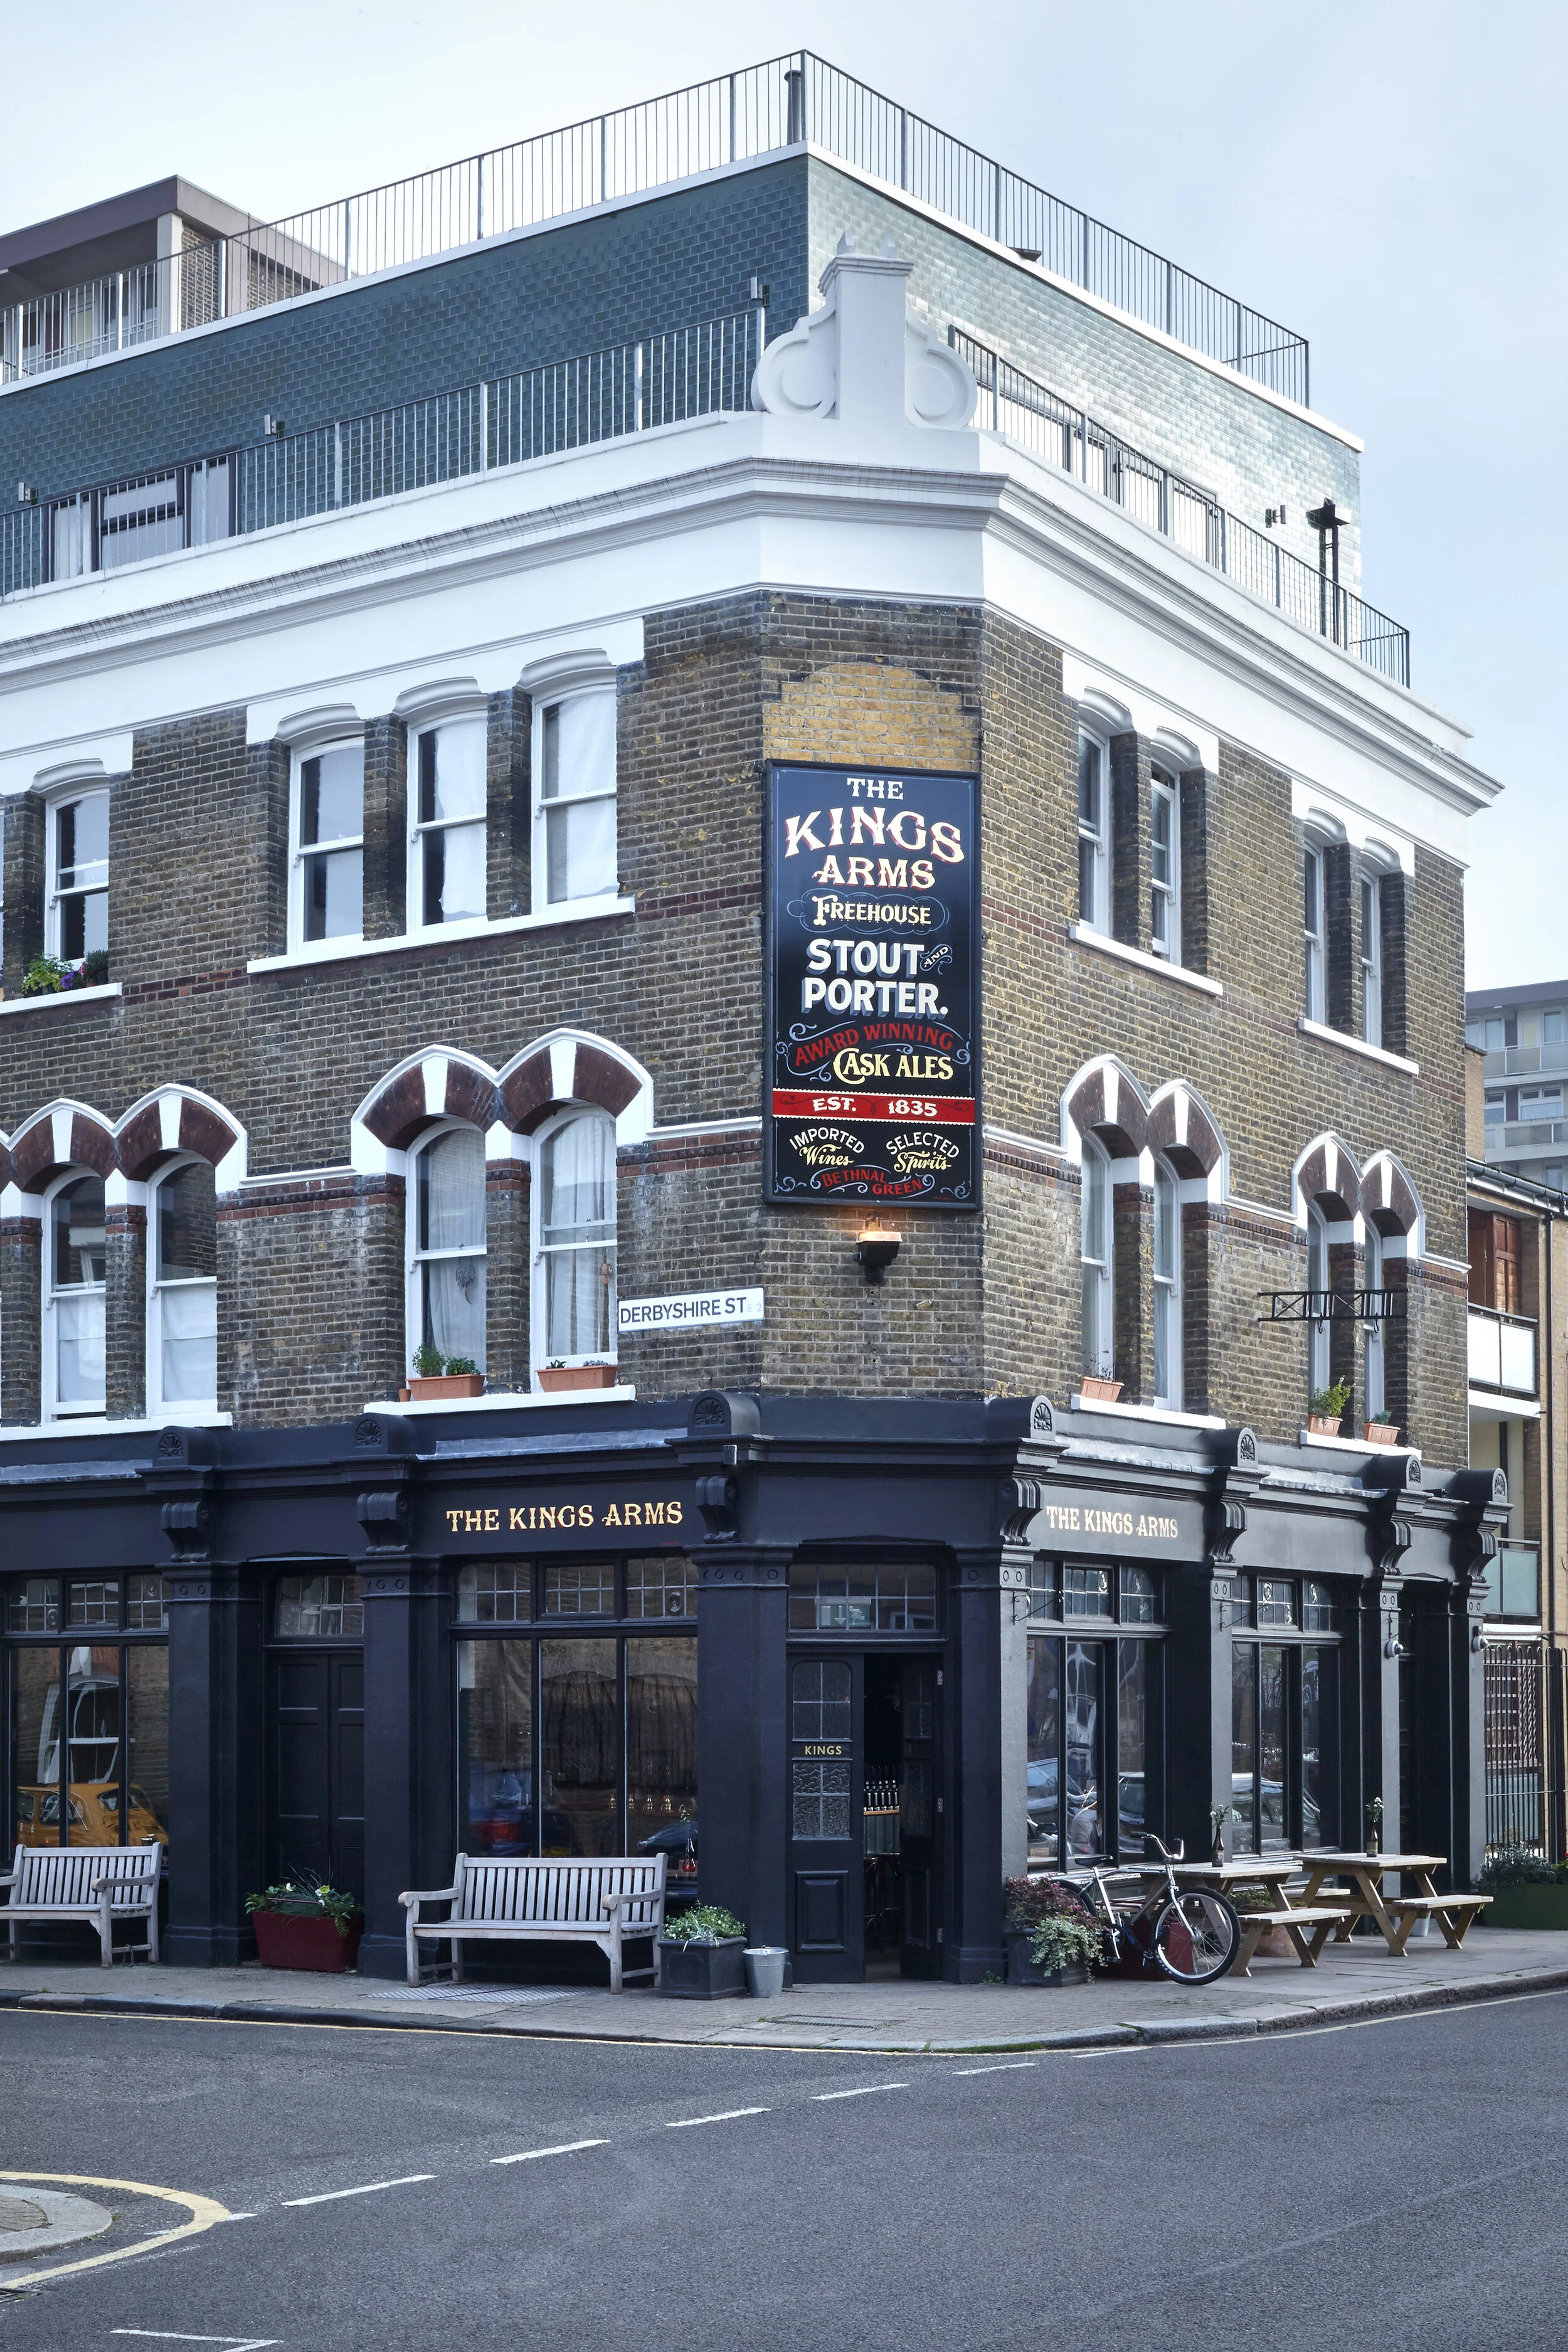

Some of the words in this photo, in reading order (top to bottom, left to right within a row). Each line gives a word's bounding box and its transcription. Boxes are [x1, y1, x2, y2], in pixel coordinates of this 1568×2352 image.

[847, 777, 904, 800] THE
[785, 806, 965, 864] KINGS
[812, 854, 936, 891] ARMS
[812, 894, 931, 926] FREEHOUSE
[806, 938, 924, 978] STOUT
[923, 946, 949, 968] AND
[802, 977, 949, 1020] PORTER.
[795, 1029, 860, 1066] AWARD
[864, 1023, 953, 1051] WINNING
[833, 1047, 891, 1084] CASK
[896, 1055, 953, 1080] ALES
[812, 1096, 857, 1112] EST.
[888, 1099, 938, 1116] 1835
[789, 1126, 865, 1154] IMPORTED
[886, 1131, 960, 1158] SELECTED
[798, 1144, 854, 1166] Wines
[893, 1150, 952, 1173] Spirits
[821, 1168, 886, 1187] BETHNAL
[872, 1179, 923, 1195] GREEN
[620, 1299, 721, 1324] DERBYSHIRE
[724, 1296, 747, 1314] ST
[446, 1508, 500, 1532] THE
[509, 1505, 595, 1530] KINGS
[601, 1501, 684, 1527] ARMS
[1046, 1505, 1080, 1530] THE
[1084, 1508, 1133, 1535] KINGS
[1136, 1515, 1179, 1539] ARMS
[805, 1745, 842, 1755] KINGS
